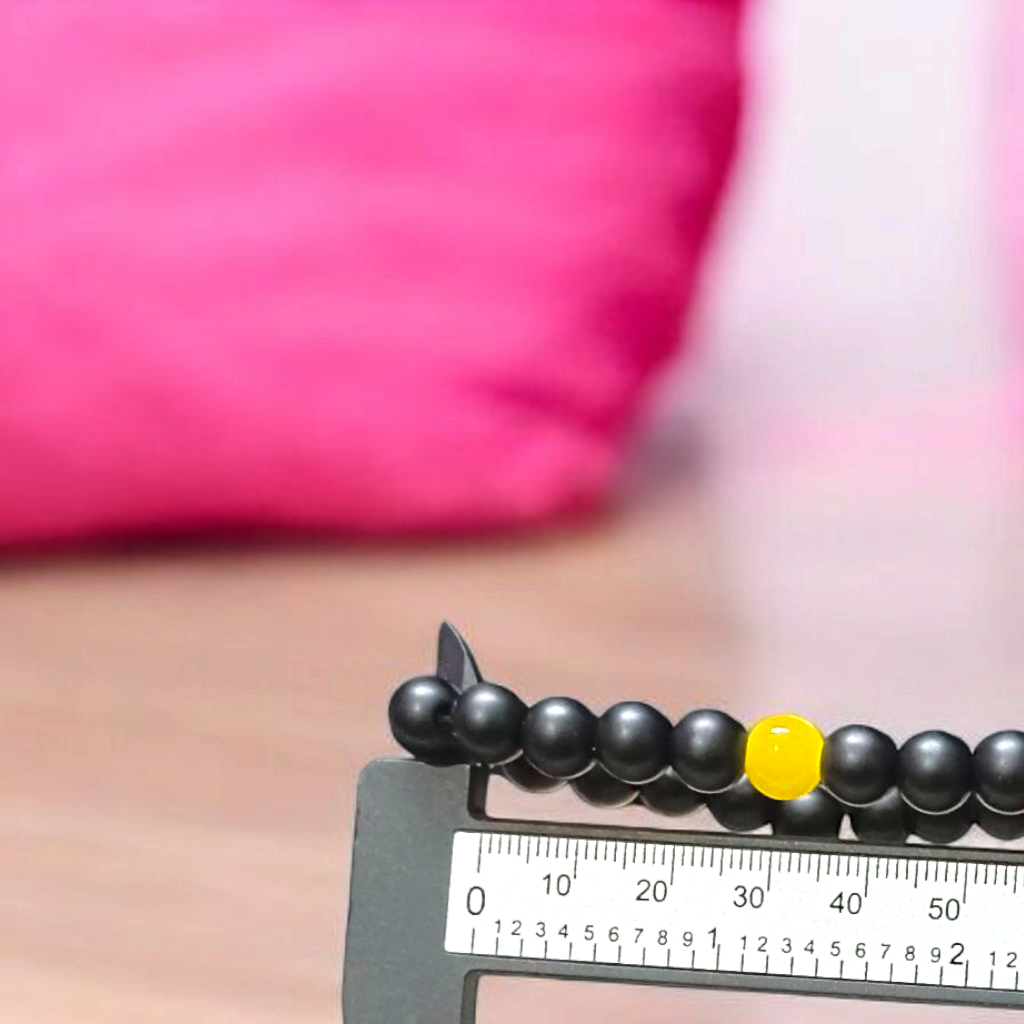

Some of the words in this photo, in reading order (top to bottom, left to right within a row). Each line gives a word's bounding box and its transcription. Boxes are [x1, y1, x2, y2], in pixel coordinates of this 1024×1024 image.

[466, 885, 486, 916] 0
[542, 873, 571, 897] 10
[635, 878, 668, 903] 20
[733, 884, 765, 909] 30
[829, 891, 862, 915] 40
[928, 897, 961, 922] 50
[493, 919, 501, 934] 1
[511, 920, 522, 936] 2
[535, 921, 546, 938] 3
[558, 923, 569, 939] 4
[584, 924, 595, 941] 5
[608, 926, 619, 943] 6
[634, 927, 644, 944] 7
[657, 929, 668, 946] 8
[682, 931, 694, 947] 9
[707, 927, 717, 949] 1
[739, 935, 747, 950] 1
[757, 936, 768, 953] 2
[781, 937, 792, 954] 3
[803, 939, 815, 955] 4
[830, 941, 841, 957] 5
[855, 942, 866, 959] 6
[881, 943, 891, 959] 7
[904, 945, 916, 962] 8
[930, 946, 941, 964] 9
[949, 942, 965, 966] 2
[988, 951, 996, 966] 1
[1006, 951, 1018, 968] 2
